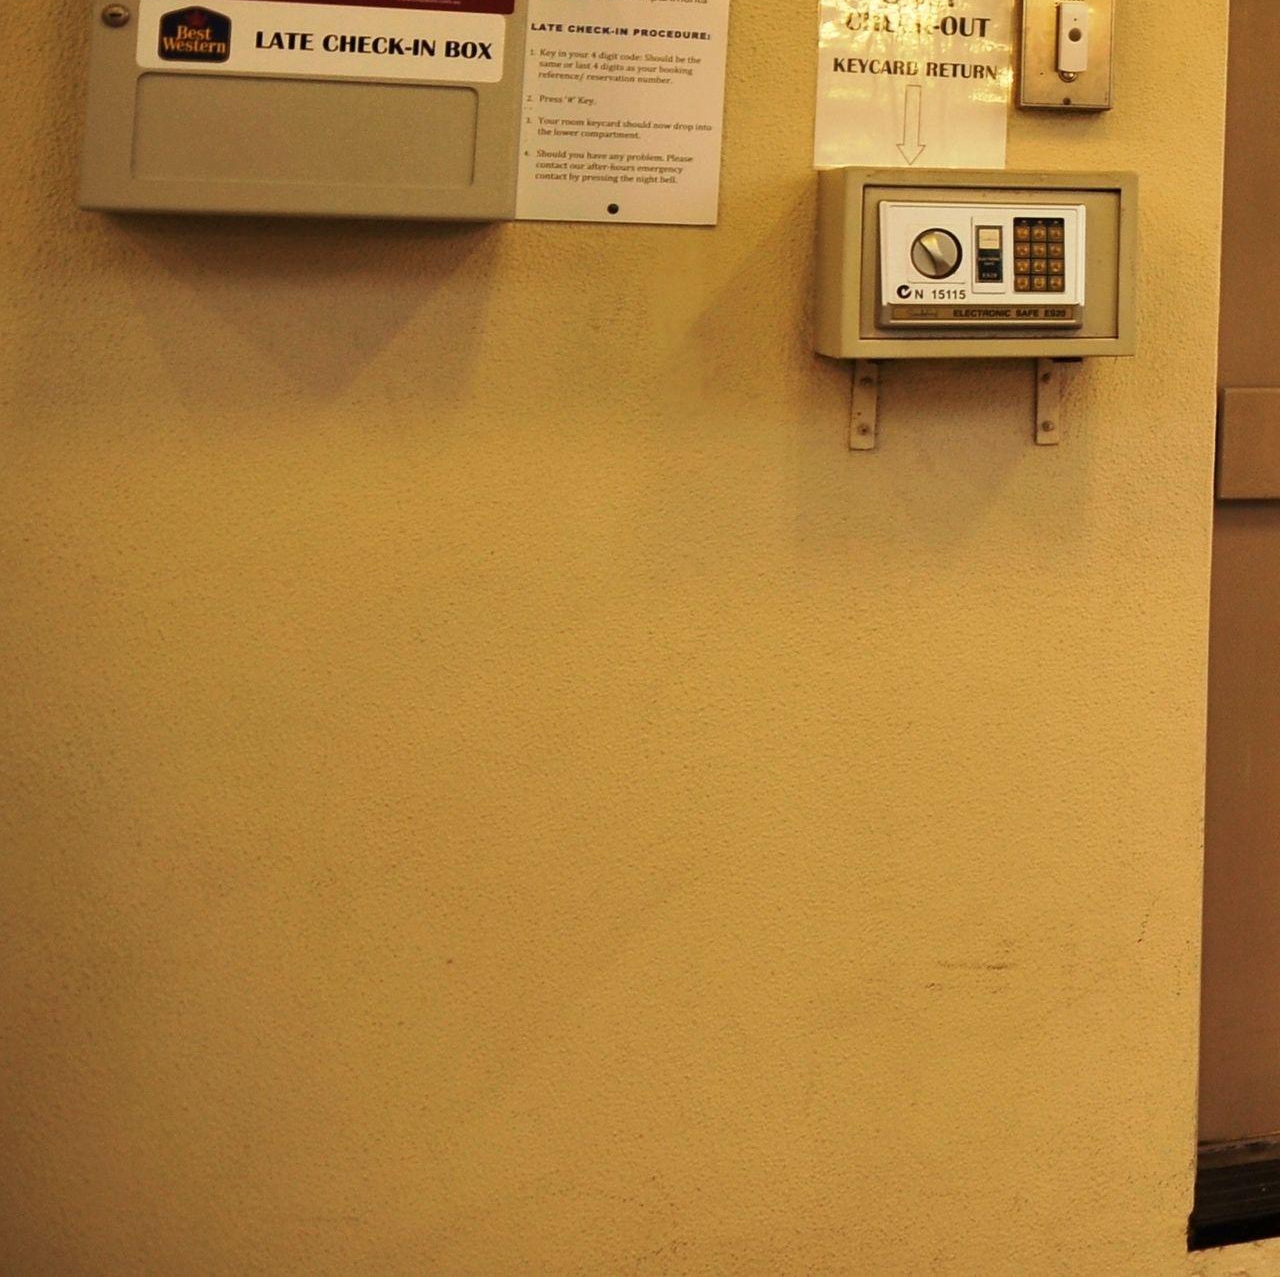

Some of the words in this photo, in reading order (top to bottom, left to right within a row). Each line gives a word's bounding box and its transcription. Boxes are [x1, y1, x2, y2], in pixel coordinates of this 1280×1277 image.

[176, 25, 213, 40] Best
[531, 23, 563, 32] LATE
[568, 25, 629, 36] CHECK-IN
[633, 28, 711, 41] PROCEDURE:
[163, 36, 226, 54] Western
[255, 31, 314, 51] LATE
[322, 34, 436, 57] CHECK-IN
[444, 40, 492, 60] BOX
[833, 58, 919, 76] KEYCARD
[926, 62, 998, 80] RETURN
[931, 289, 966, 300] 15115
[953, 310, 1010, 318] ELECTRONIC
[1015, 310, 1040, 318] SAFE
